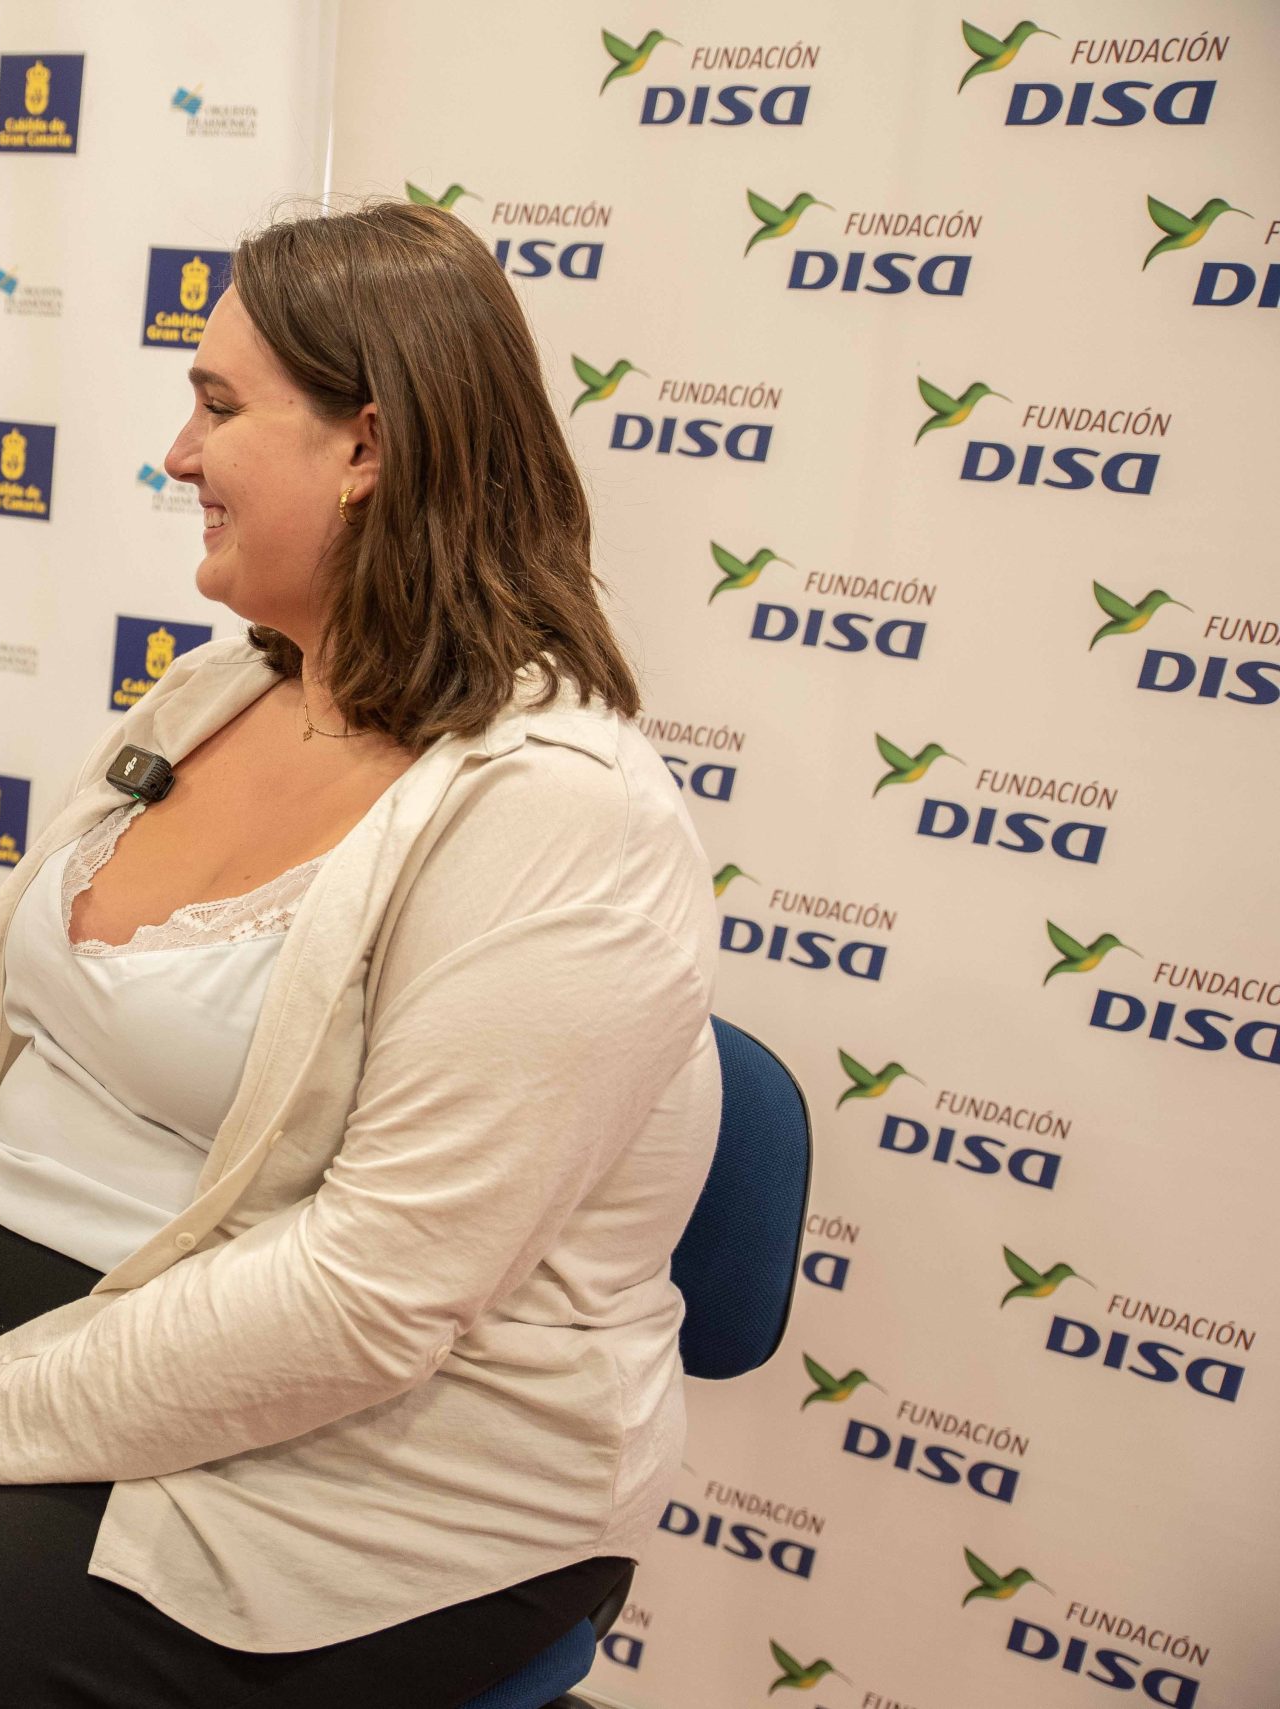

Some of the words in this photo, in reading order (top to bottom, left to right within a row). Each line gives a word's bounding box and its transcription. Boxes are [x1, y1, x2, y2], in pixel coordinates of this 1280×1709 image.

[690, 40, 821, 70] FUNDACIÓN
[1070, 31, 1230, 65] FUNDACIÓN
[640, 85, 811, 126] DISA
[1004, 80, 1218, 126] DISA
[492, 201, 613, 228] FUNDACIÓN
[844, 209, 983, 239] FUNDACIÓN
[495, 239, 605, 281] ISA
[787, 249, 973, 297] DISA
[146, 324, 180, 341] Gran
[658, 379, 783, 410] FUNDACIÓN
[608, 413, 774, 463] DISA
[1022, 404, 1172, 437] FUNDACIÓN
[959, 440, 1161, 495] DISA
[804, 570, 937, 607] FUNDACIÓN
[749, 602, 927, 660] DISA
[1136, 648, 1280, 706] DIS
[639, 717, 746, 752] UNDACIÓN
[975, 768, 1119, 811] FUNDACIÓN
[916, 798, 1108, 865] DISA
[769, 888, 899, 932] FUNDACIÓN
[719, 915, 888, 982] DISA
[935, 1090, 1073, 1140] FUNDACIÓN
[878, 1114, 1063, 1191] DISA
[1107, 1293, 1257, 1353] FUNDACIÓN
[1045, 1314, 1246, 1403] DISA
[896, 1400, 1030, 1457] FUNDACIÓN
[842, 1418, 1020, 1505] DISA
[704, 1479, 826, 1536] FUNDACIÓN
[657, 1500, 816, 1581] DISA
[1066, 1600, 1210, 1667] FUNDACIÓN
[1006, 1616, 1200, 1709] DISA
